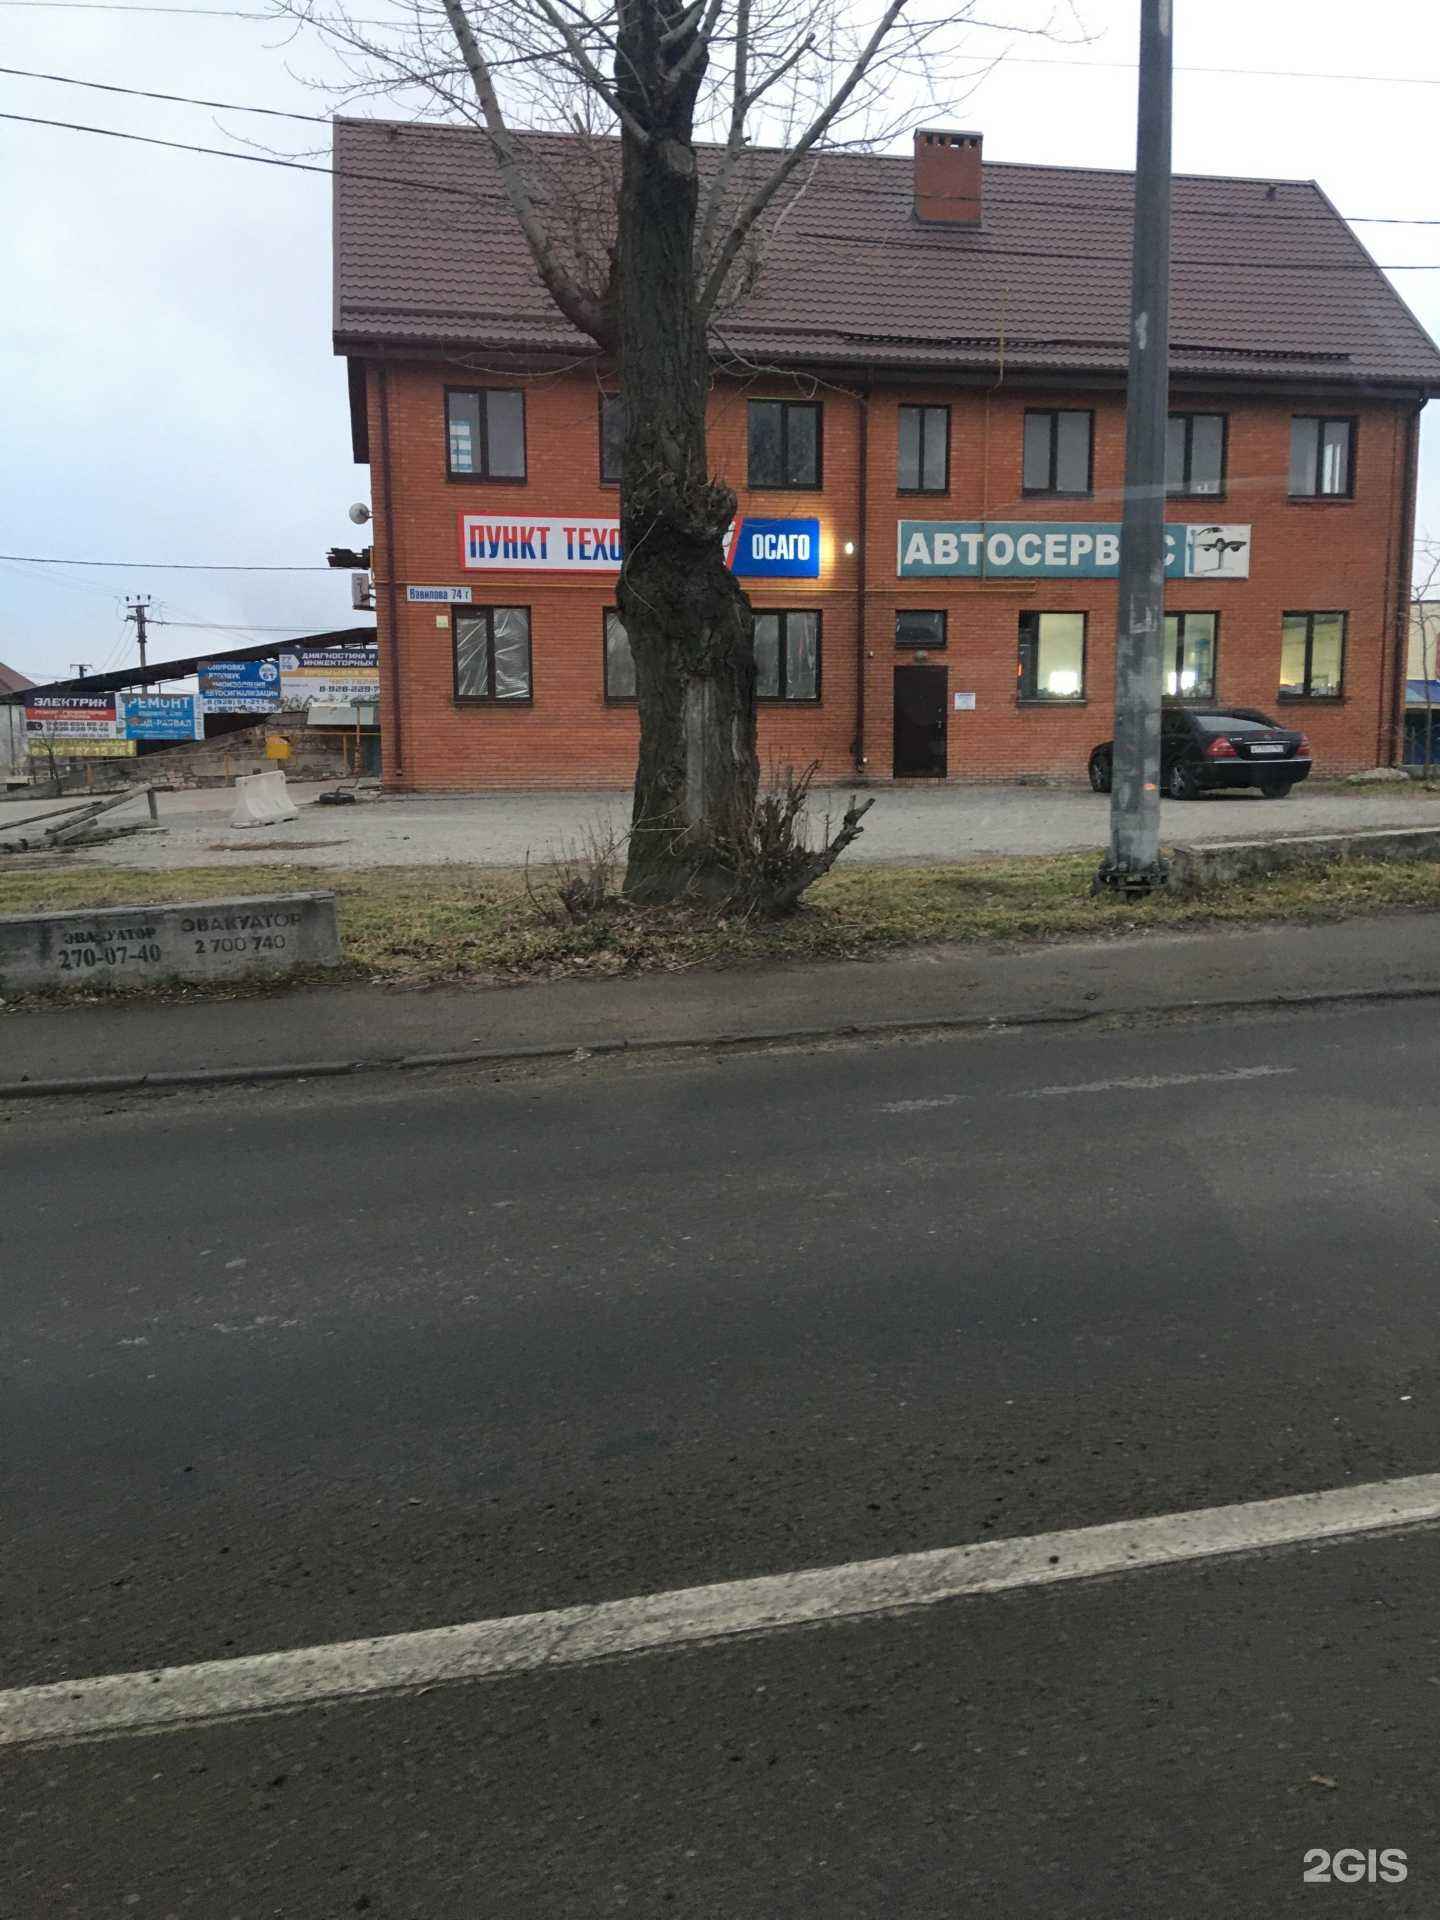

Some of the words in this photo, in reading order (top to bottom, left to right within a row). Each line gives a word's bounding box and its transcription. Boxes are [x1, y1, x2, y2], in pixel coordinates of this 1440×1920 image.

[469, 524, 550, 560] ПУНКТ
[562, 527, 625, 561] ТЕХО
[752, 533, 810, 560] ОСАГО
[904, 532, 1176, 567] АВТОСЕРВС
[409, 588, 448, 600] Вавилова
[451, 589, 462, 600] 74
[33, 697, 107, 707] ЭЛЕКТРИК
[181, 913, 300, 932] ЭВАКУАТОР
[251, 935, 286, 950] 740
[58, 944, 162, 970] 270-07-40
